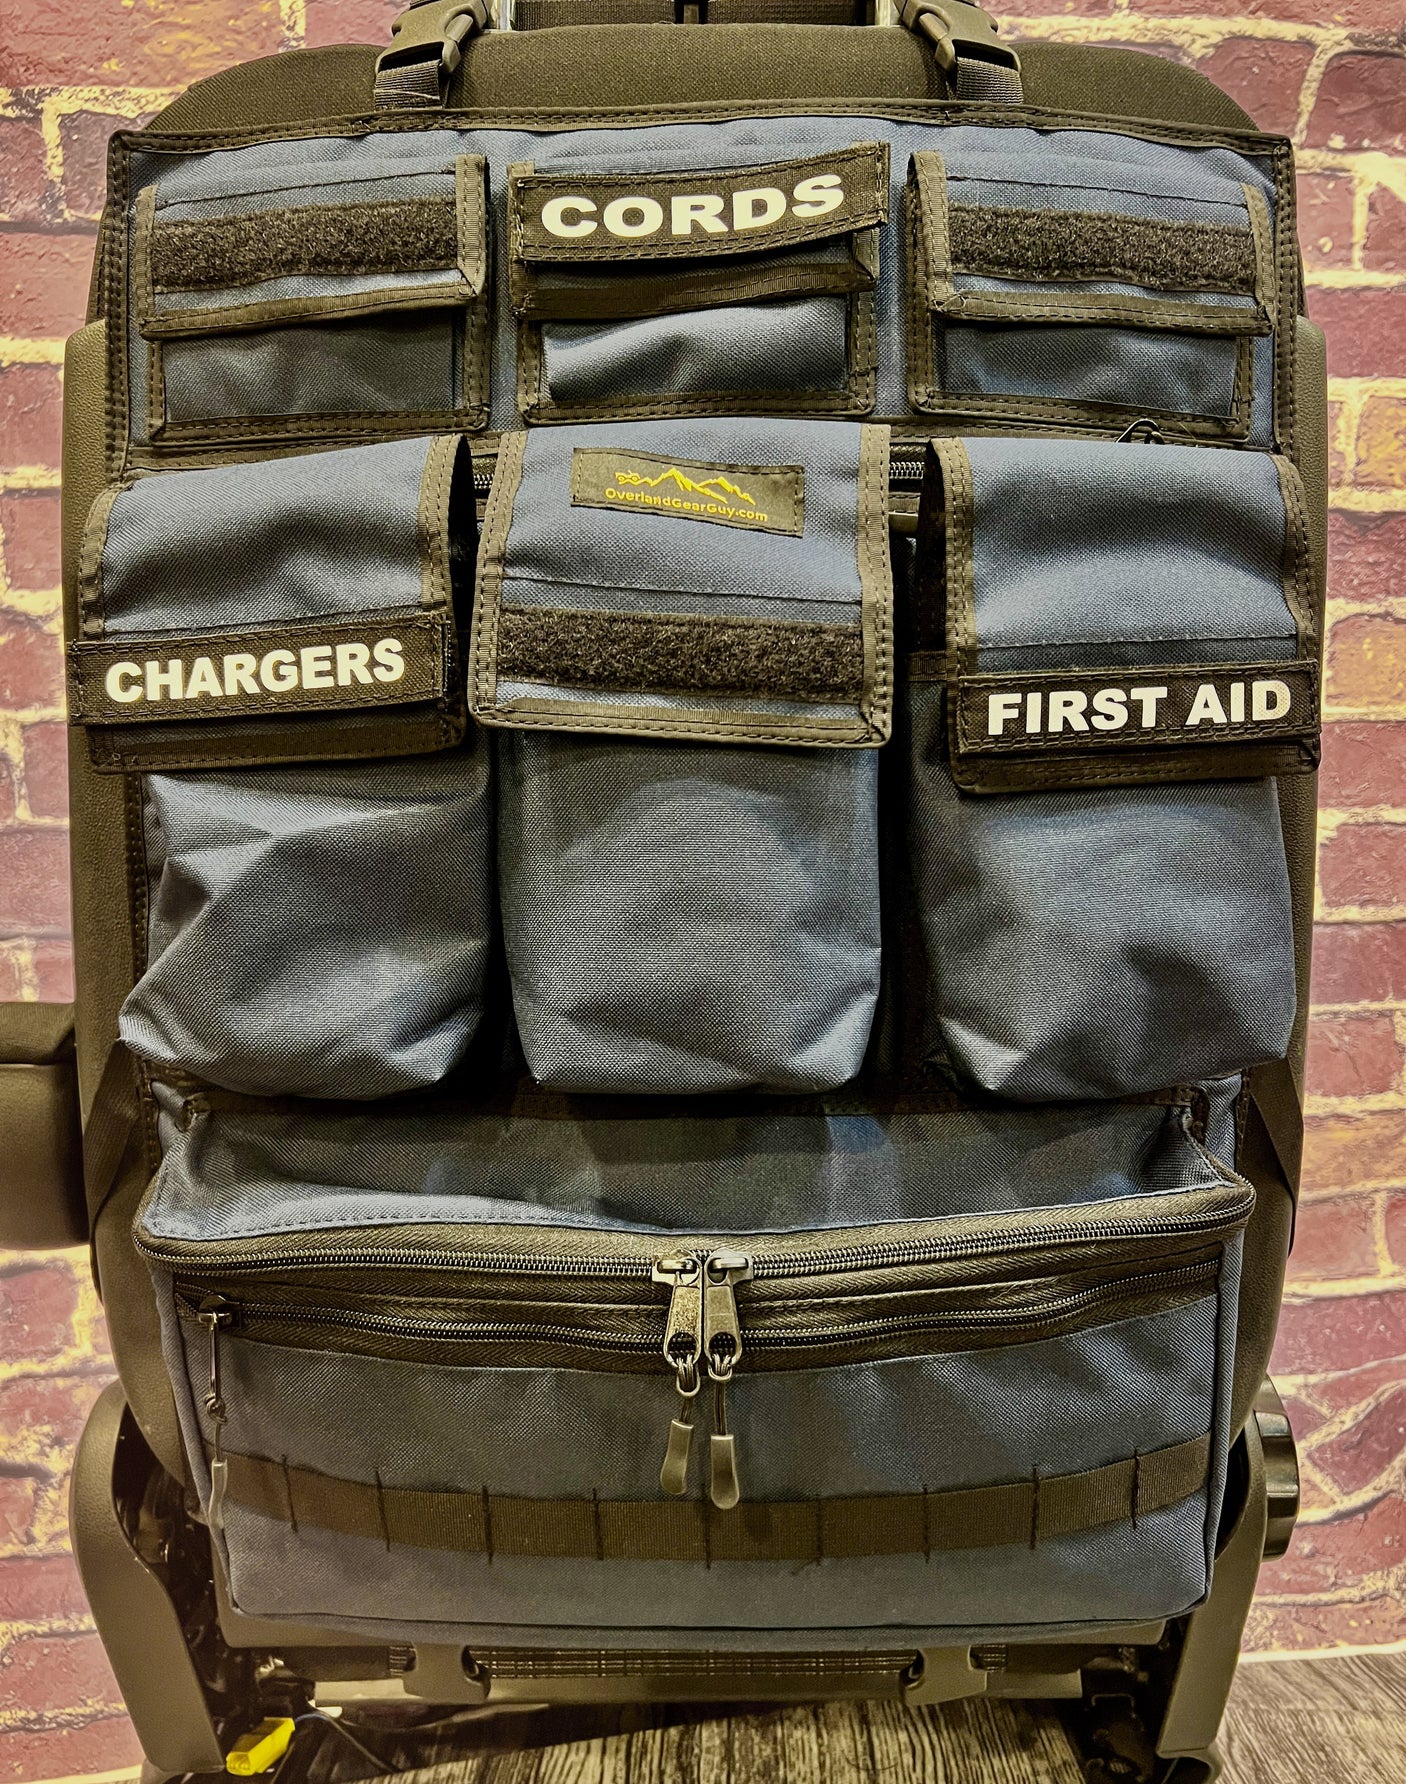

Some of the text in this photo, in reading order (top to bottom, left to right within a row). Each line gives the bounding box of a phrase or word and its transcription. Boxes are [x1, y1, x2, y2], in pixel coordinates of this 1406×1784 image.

[541, 174, 845, 239] CORDS
[605, 488, 769, 523] OverlandGearGuy.com
[105, 638, 405, 704] CHARGERS
[987, 679, 1291, 737] FIRST AID
